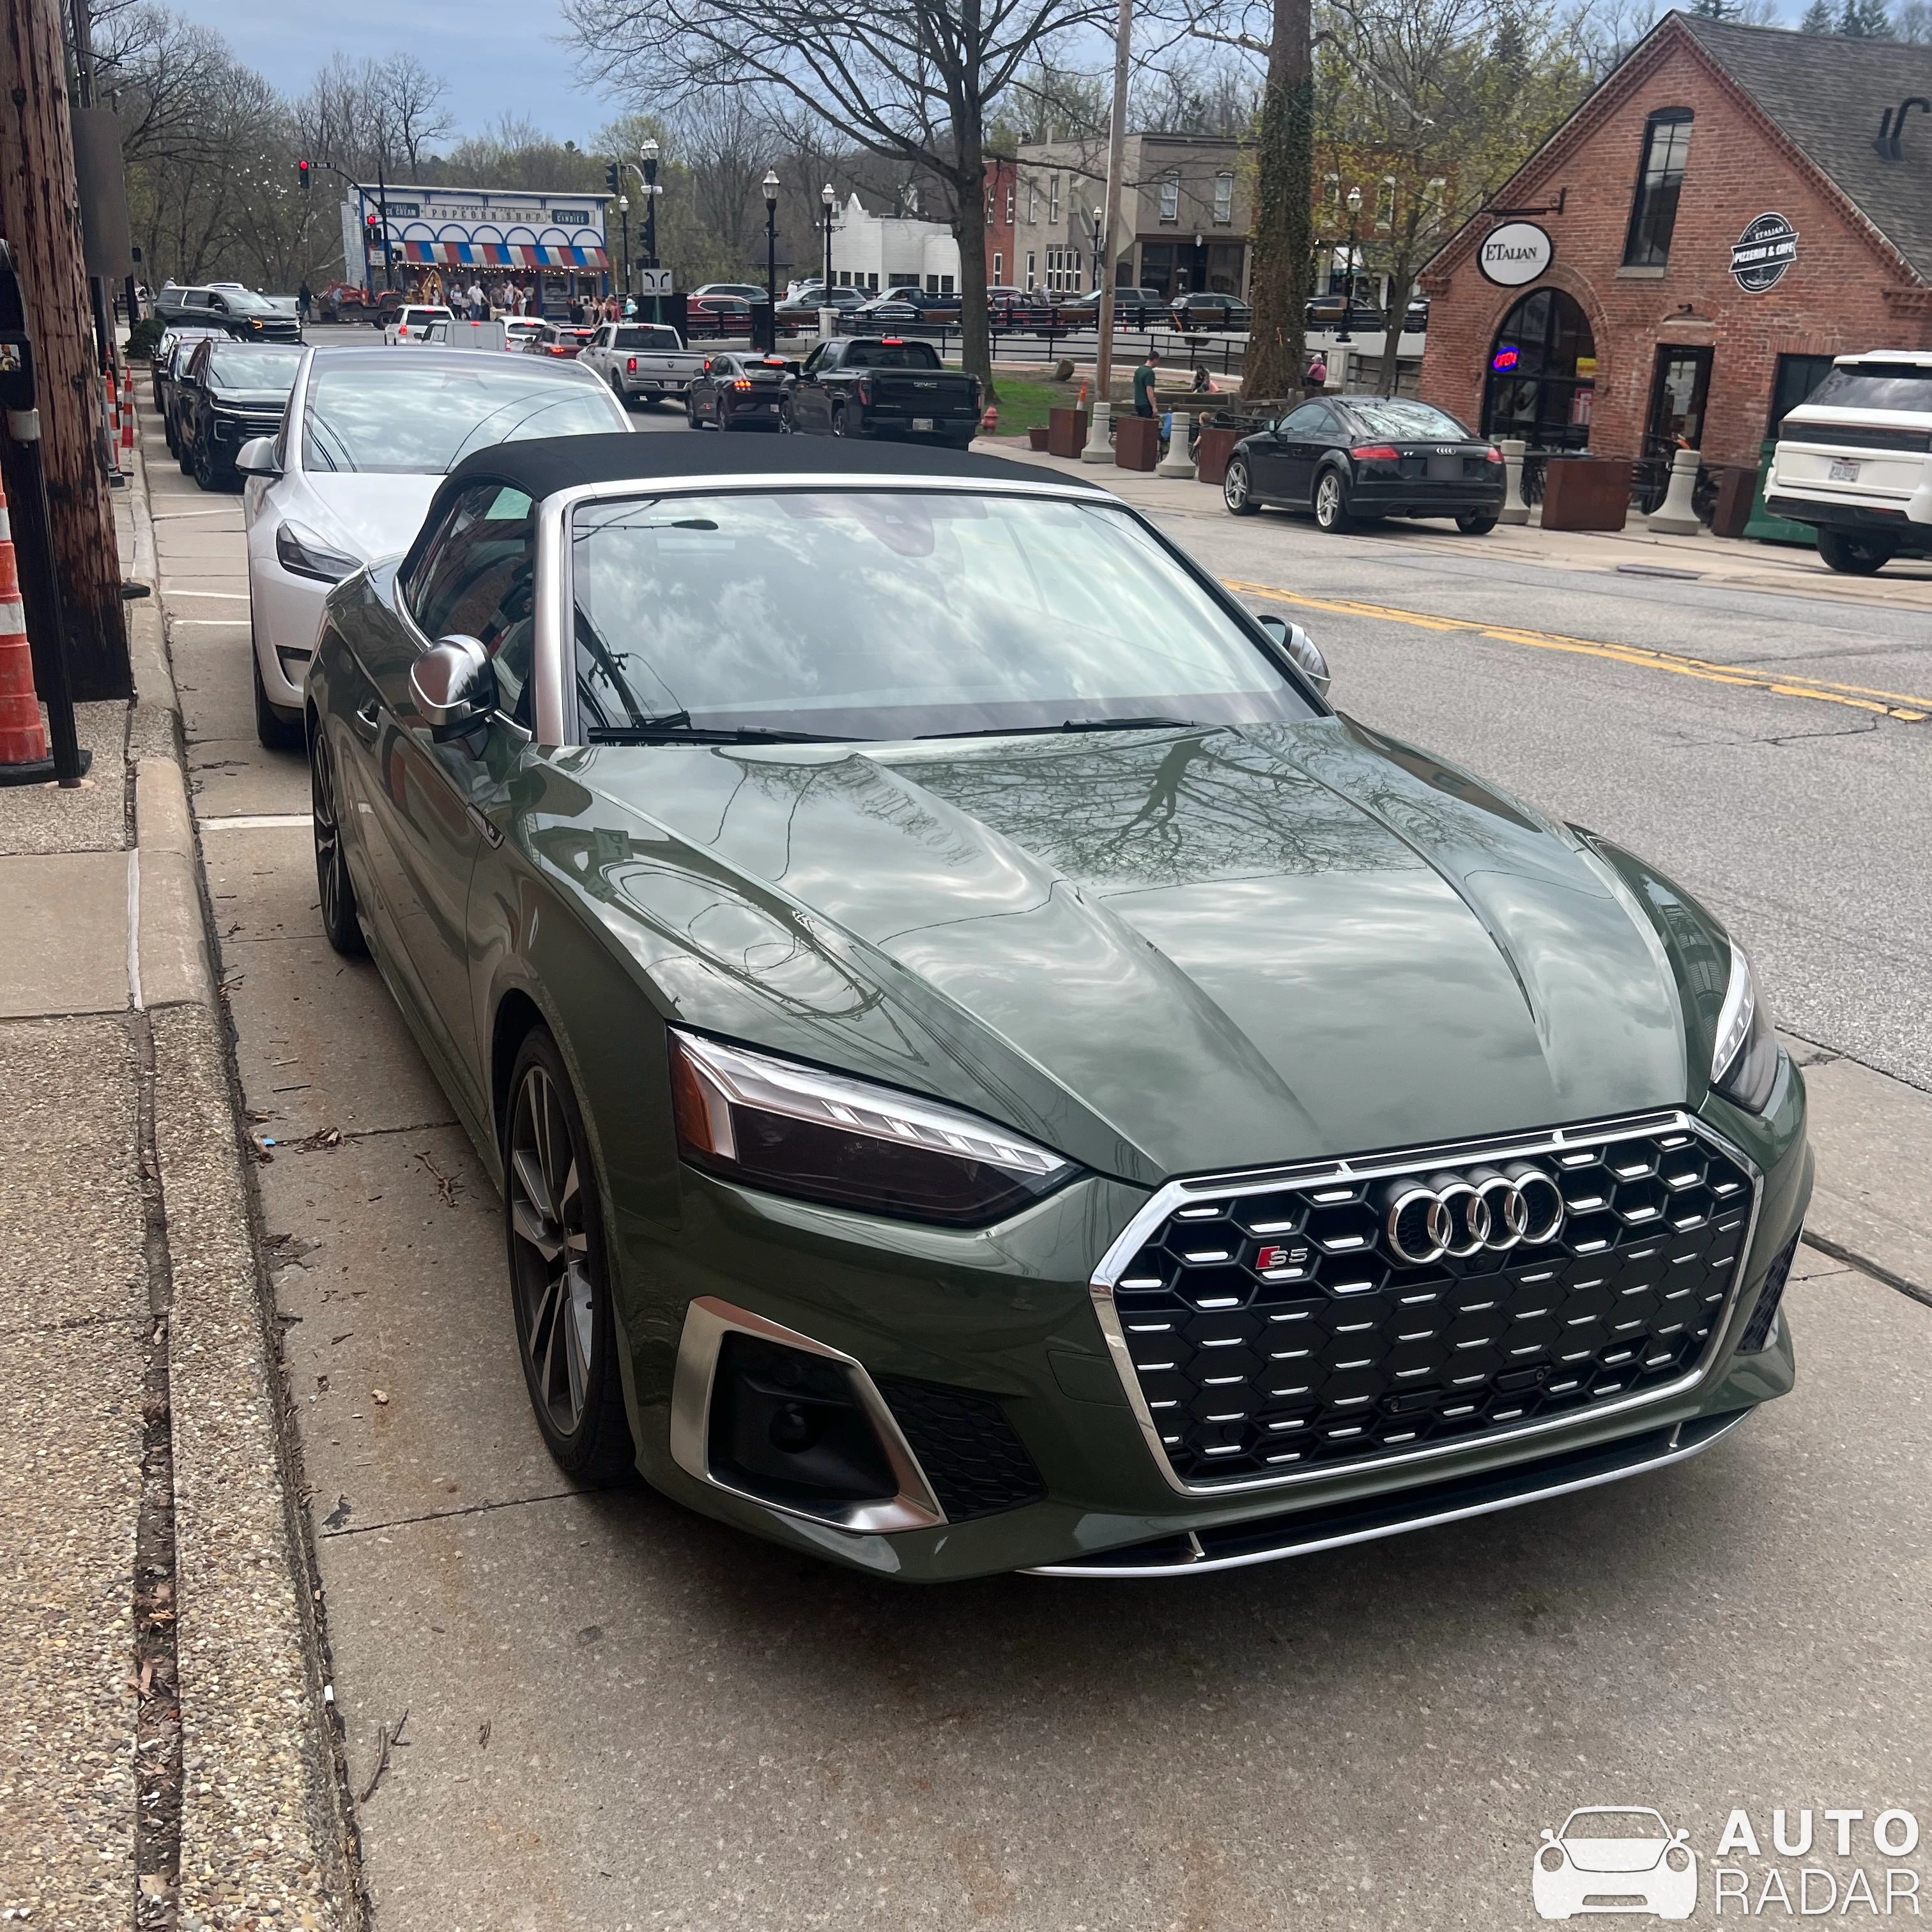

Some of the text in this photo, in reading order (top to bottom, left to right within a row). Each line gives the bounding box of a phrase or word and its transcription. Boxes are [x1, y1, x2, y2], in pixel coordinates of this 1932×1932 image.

[432, 209, 496, 220] POPCORN
[506, 212, 541, 221] SHOP
[1768, 246, 1775, 257] &
[1268, 1247, 1308, 1266] S5
